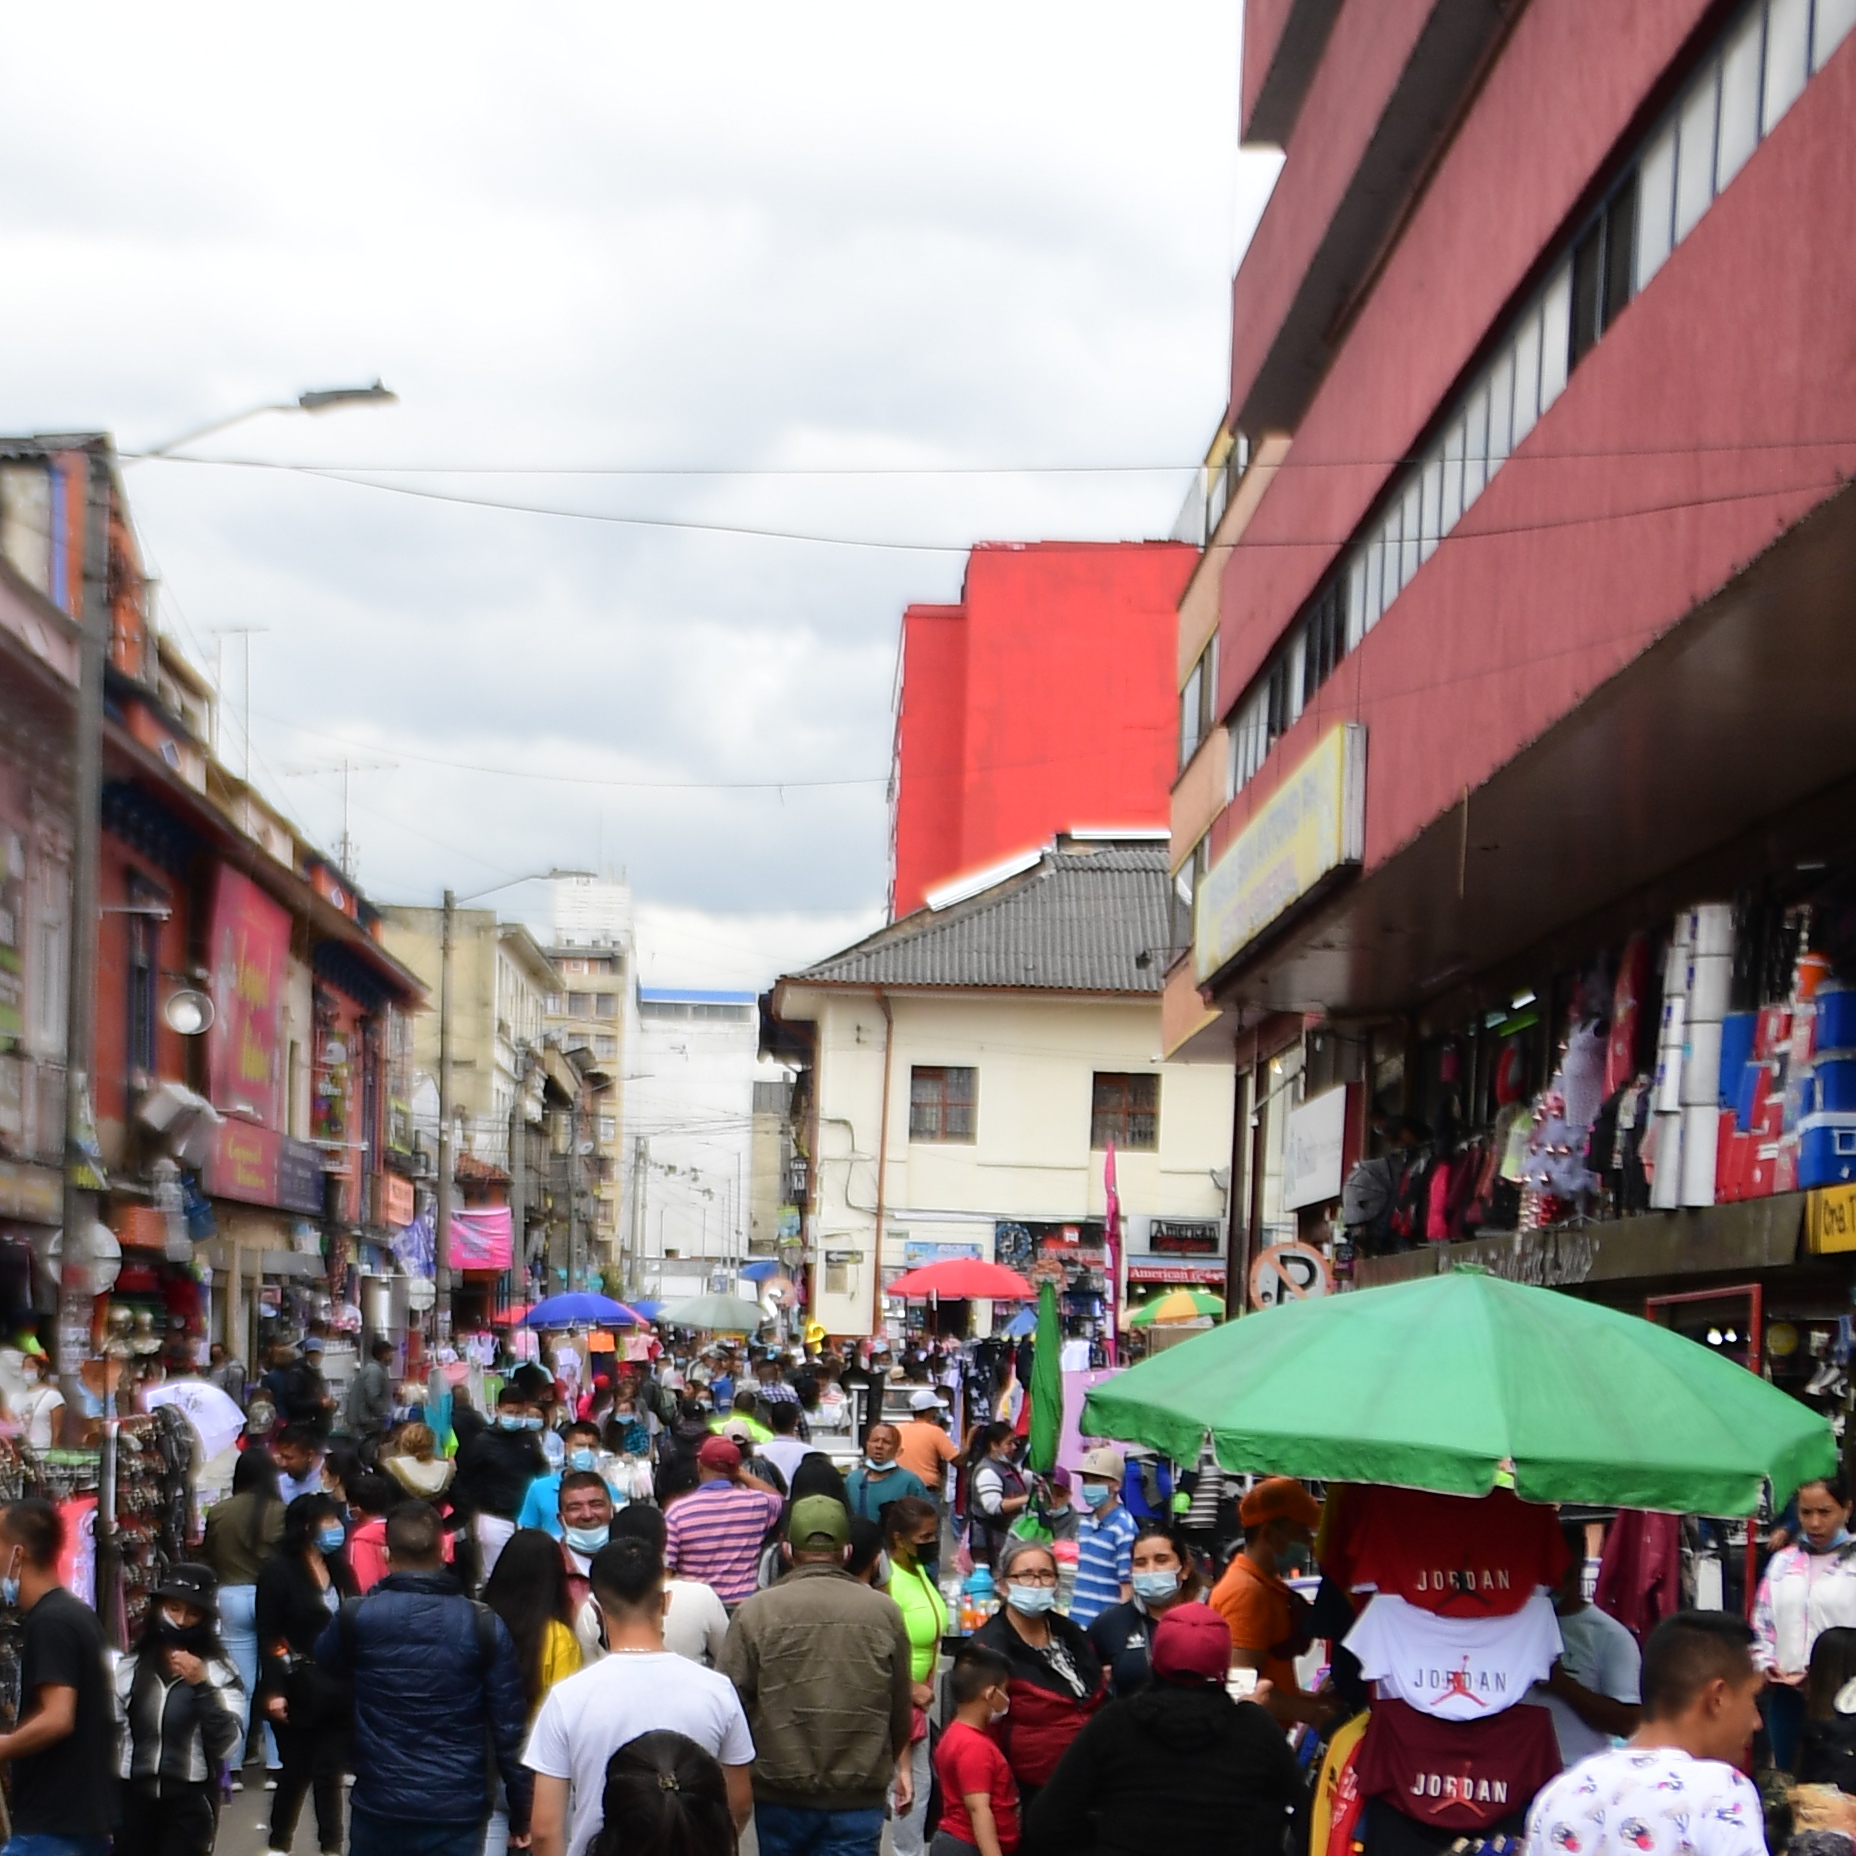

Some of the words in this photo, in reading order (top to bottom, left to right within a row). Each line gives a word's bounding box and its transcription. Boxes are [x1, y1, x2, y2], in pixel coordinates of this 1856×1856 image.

[1129, 1267, 1189, 1281] American
[1416, 1568, 1511, 1592] JORDAN
[1413, 1667, 1507, 1693] JORDAN
[1410, 1772, 1508, 1804] JORDAN
